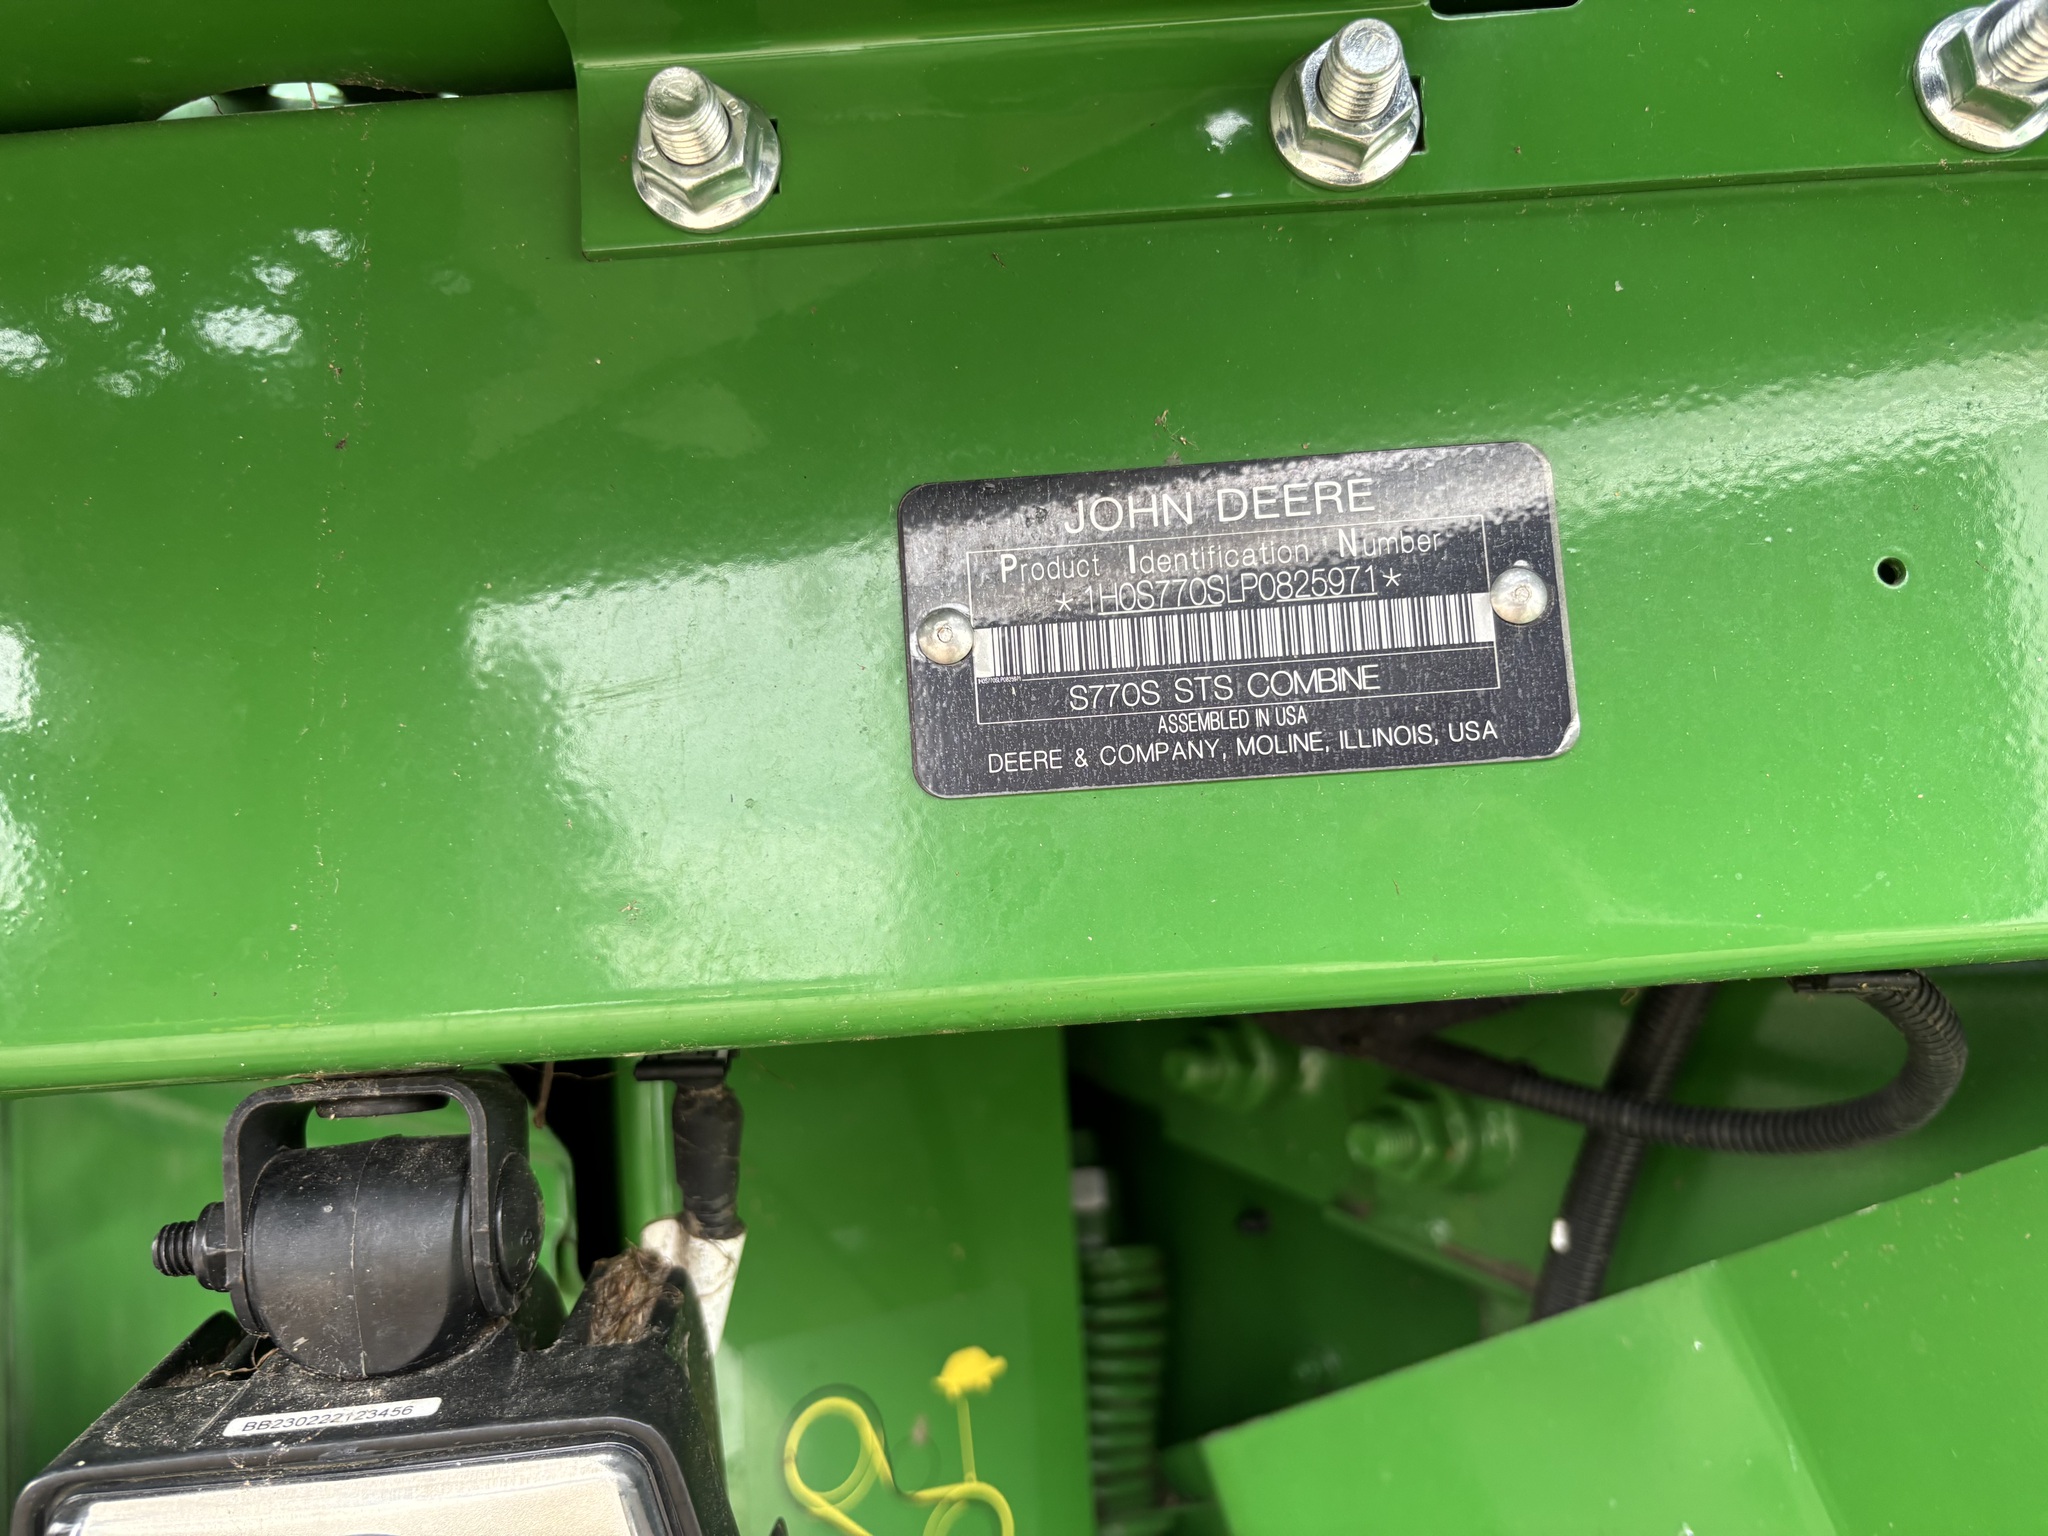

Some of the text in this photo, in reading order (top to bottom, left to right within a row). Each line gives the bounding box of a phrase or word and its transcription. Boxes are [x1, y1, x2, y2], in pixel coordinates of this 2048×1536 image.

[1065, 478, 1376, 534] JOHN DEERE
[1000, 528, 1441, 583] Product Identification Number
[1069, 664, 1381, 711] S770S STS COMBINE
[1157, 705, 1308, 734] ASSEMBLED IN USA
[988, 720, 1499, 774] DEERE & COMPANY, MOLINE, ILLINOIS, USA
[242, 1405, 414, 1432] BB230222123456
